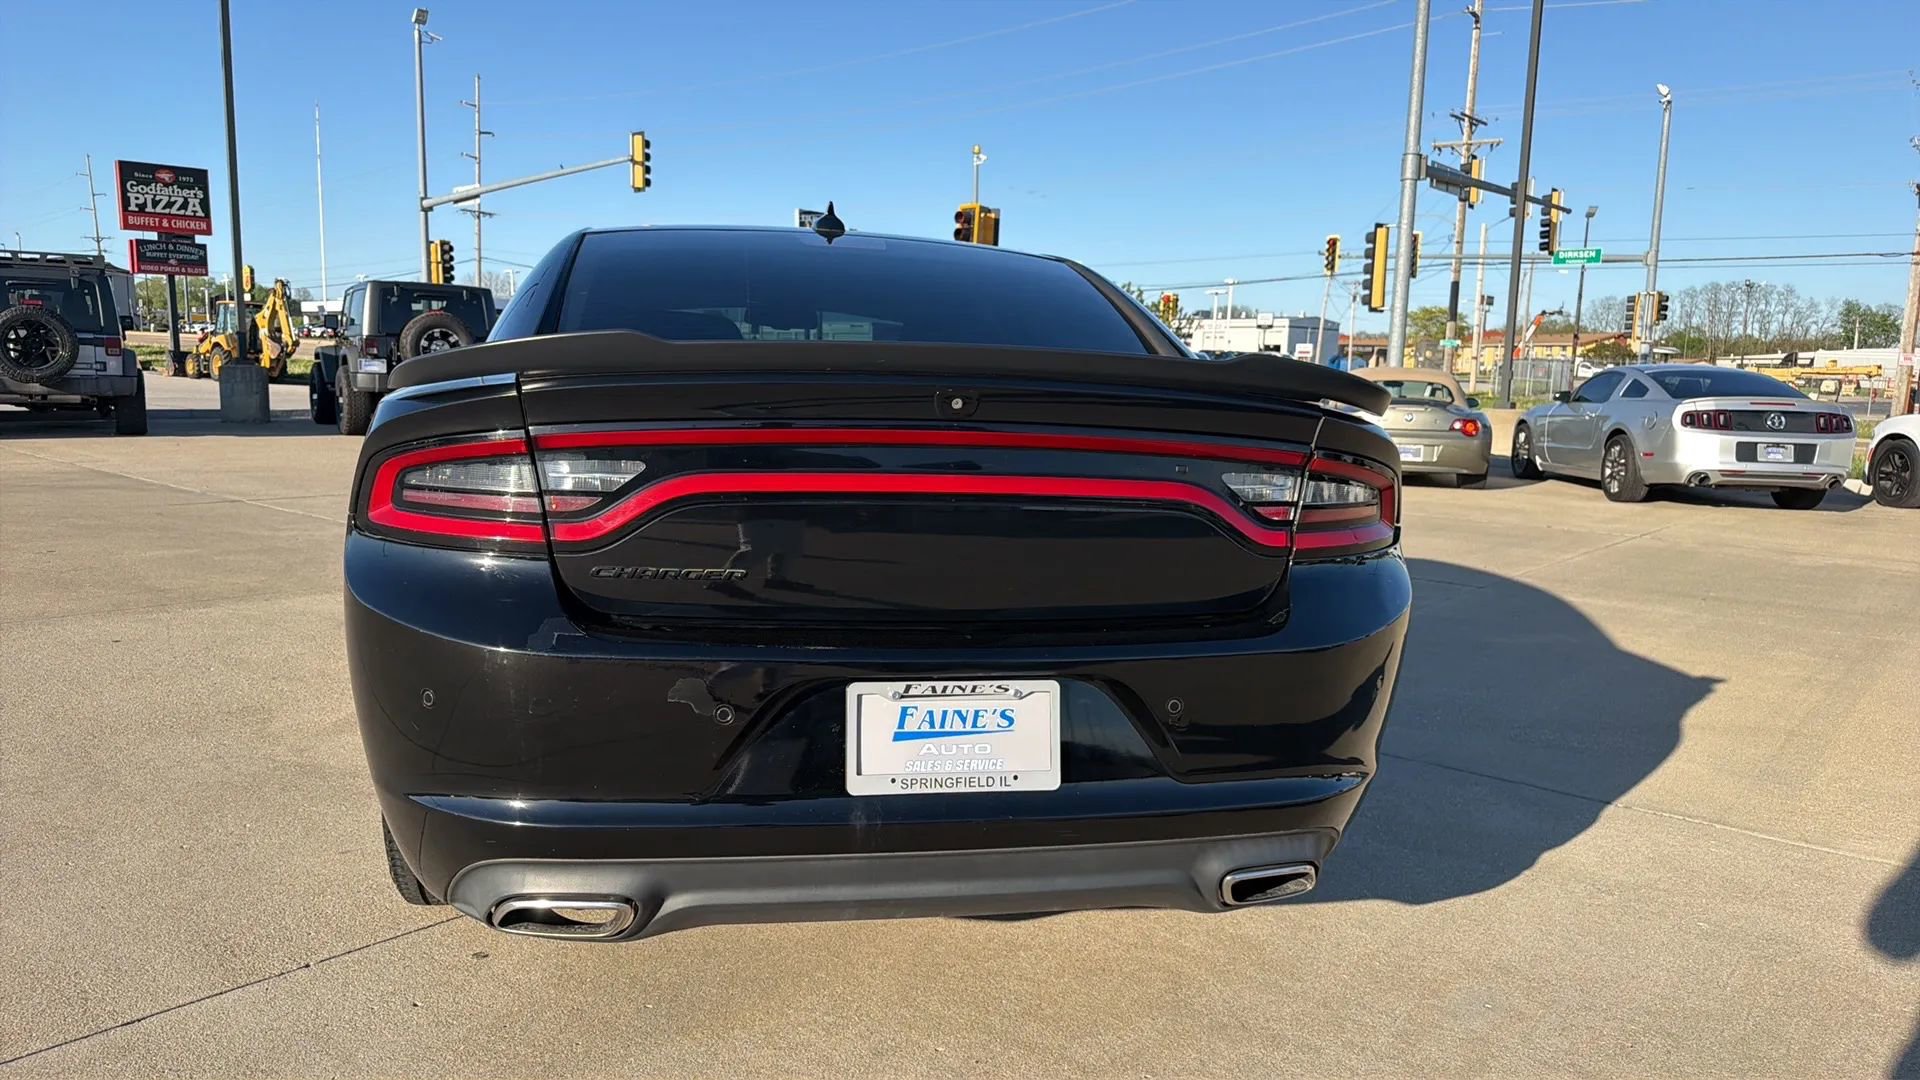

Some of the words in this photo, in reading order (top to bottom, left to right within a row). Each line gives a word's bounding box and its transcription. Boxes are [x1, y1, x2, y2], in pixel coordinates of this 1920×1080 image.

[126, 180, 204, 199] Godfather's
[127, 192, 205, 217] PIZZA
[128, 216, 160, 227] BUFFET
[161, 219, 170, 228] &
[171, 220, 207, 230] CHICKEN
[139, 243, 167, 253] LUNCH
[176, 244, 206, 257] DINNER
[1558, 250, 1596, 259] DIRKSEN
[140, 264, 159, 272] VIDEO
[187, 266, 206, 274] SLOTS
[589, 565, 749, 582] CHARGER
[902, 683, 1011, 695] FAINE'S
[896, 704, 1016, 731] FAINE'S
[919, 743, 992, 756] AUTO
[905, 759, 942, 773] SALES
[944, 759, 955, 772] &
[956, 758, 1004, 771] SERVICE
[900, 776, 996, 790] SPRINGFIELD
[999, 775, 1011, 788] IL
